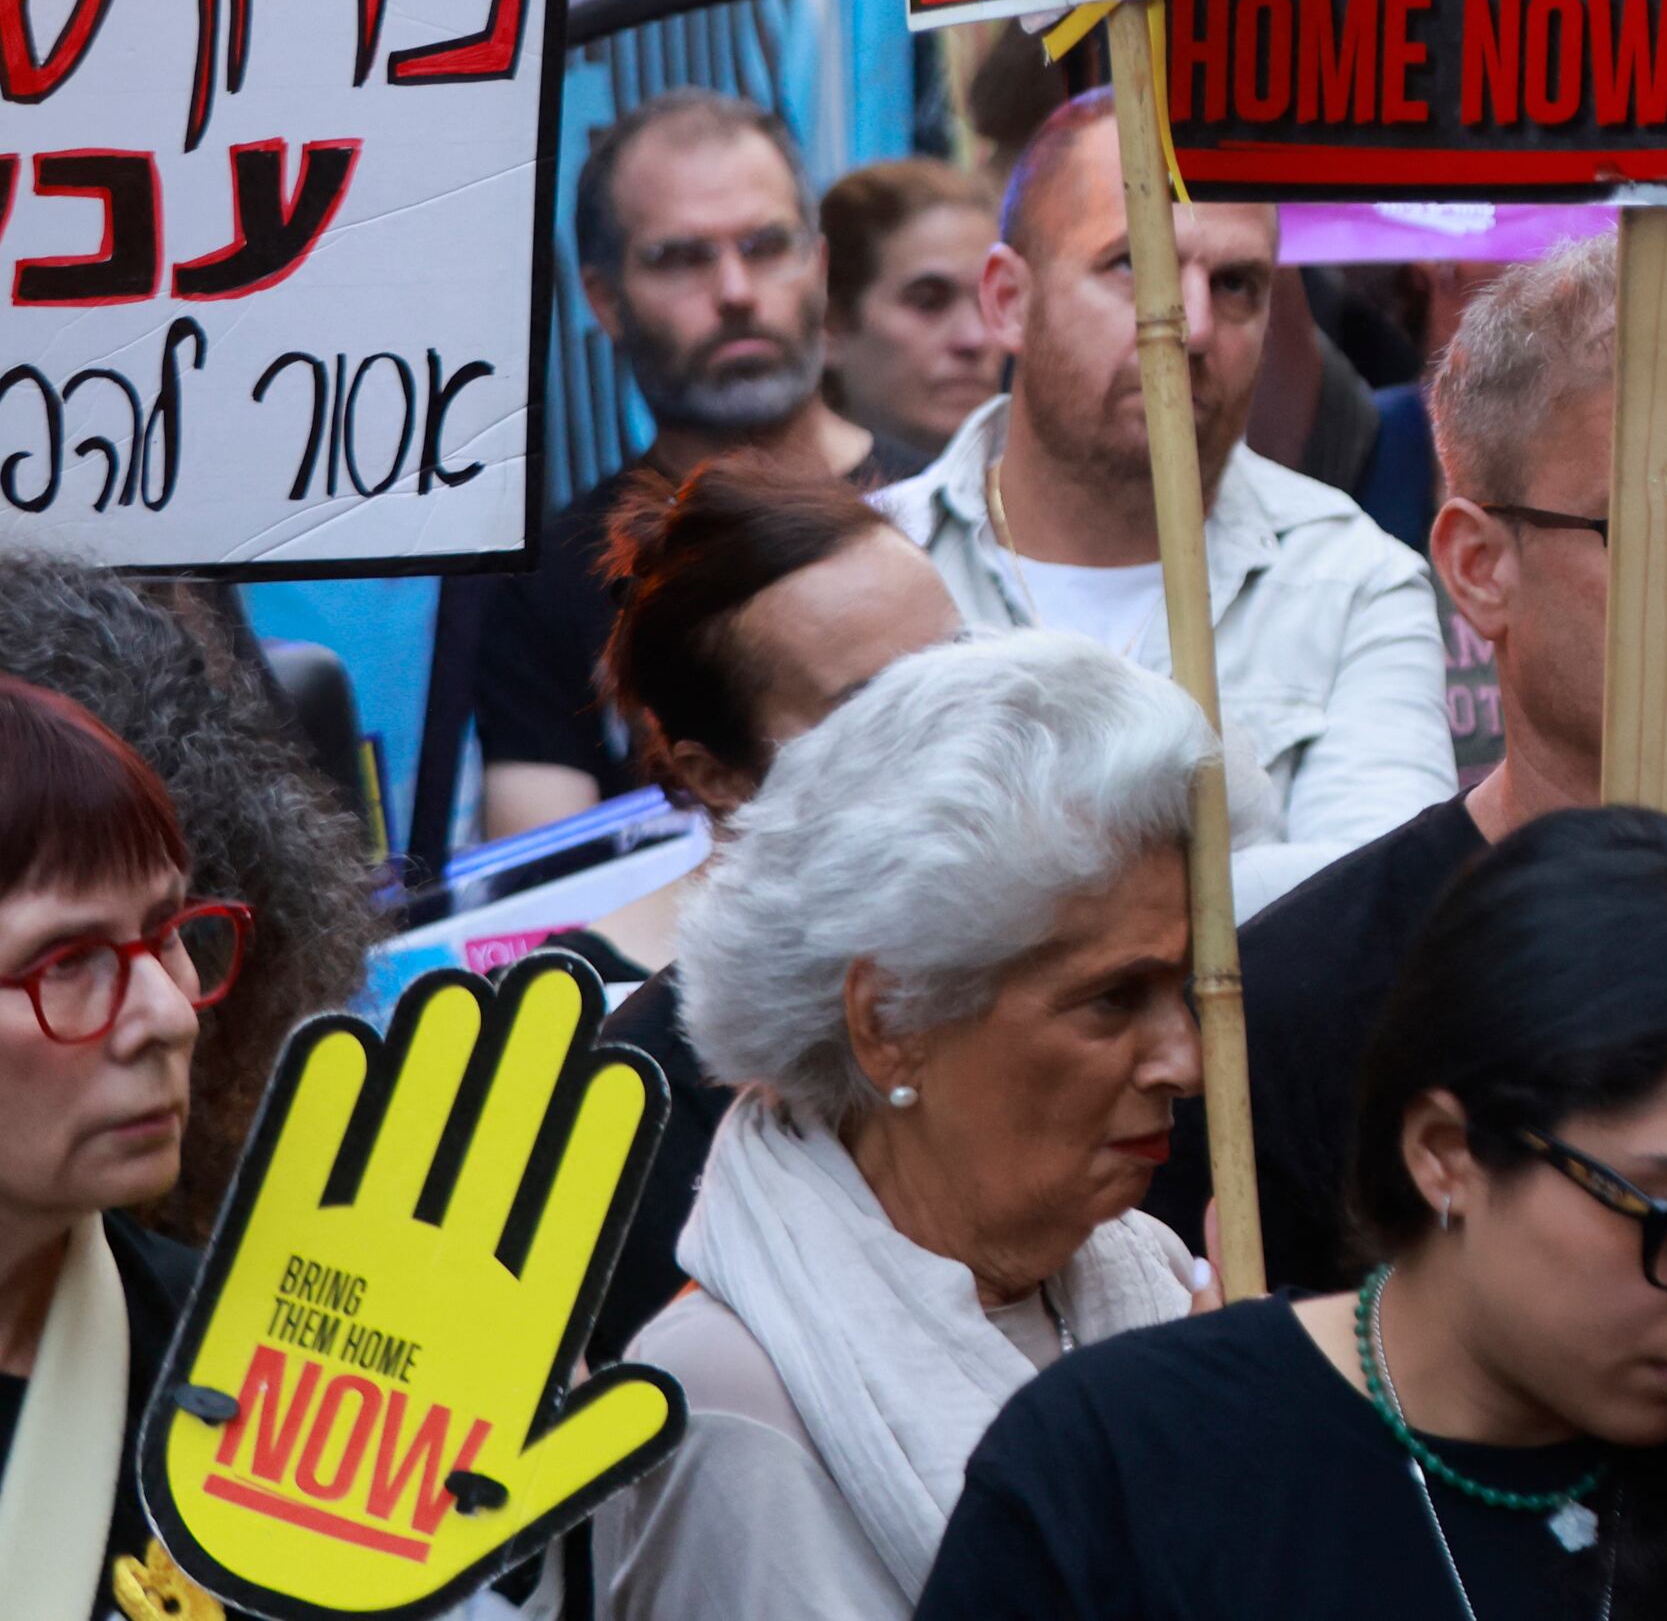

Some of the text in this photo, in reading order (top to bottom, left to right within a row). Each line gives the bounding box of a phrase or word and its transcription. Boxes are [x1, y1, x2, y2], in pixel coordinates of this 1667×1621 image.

[0, 138, 364, 305] עכ
[253, 348, 495, 502] אסור
[267, 1297, 422, 1382] THEM HOME
[278, 1254, 367, 1317] BRING
[215, 1343, 493, 1537] NOW
